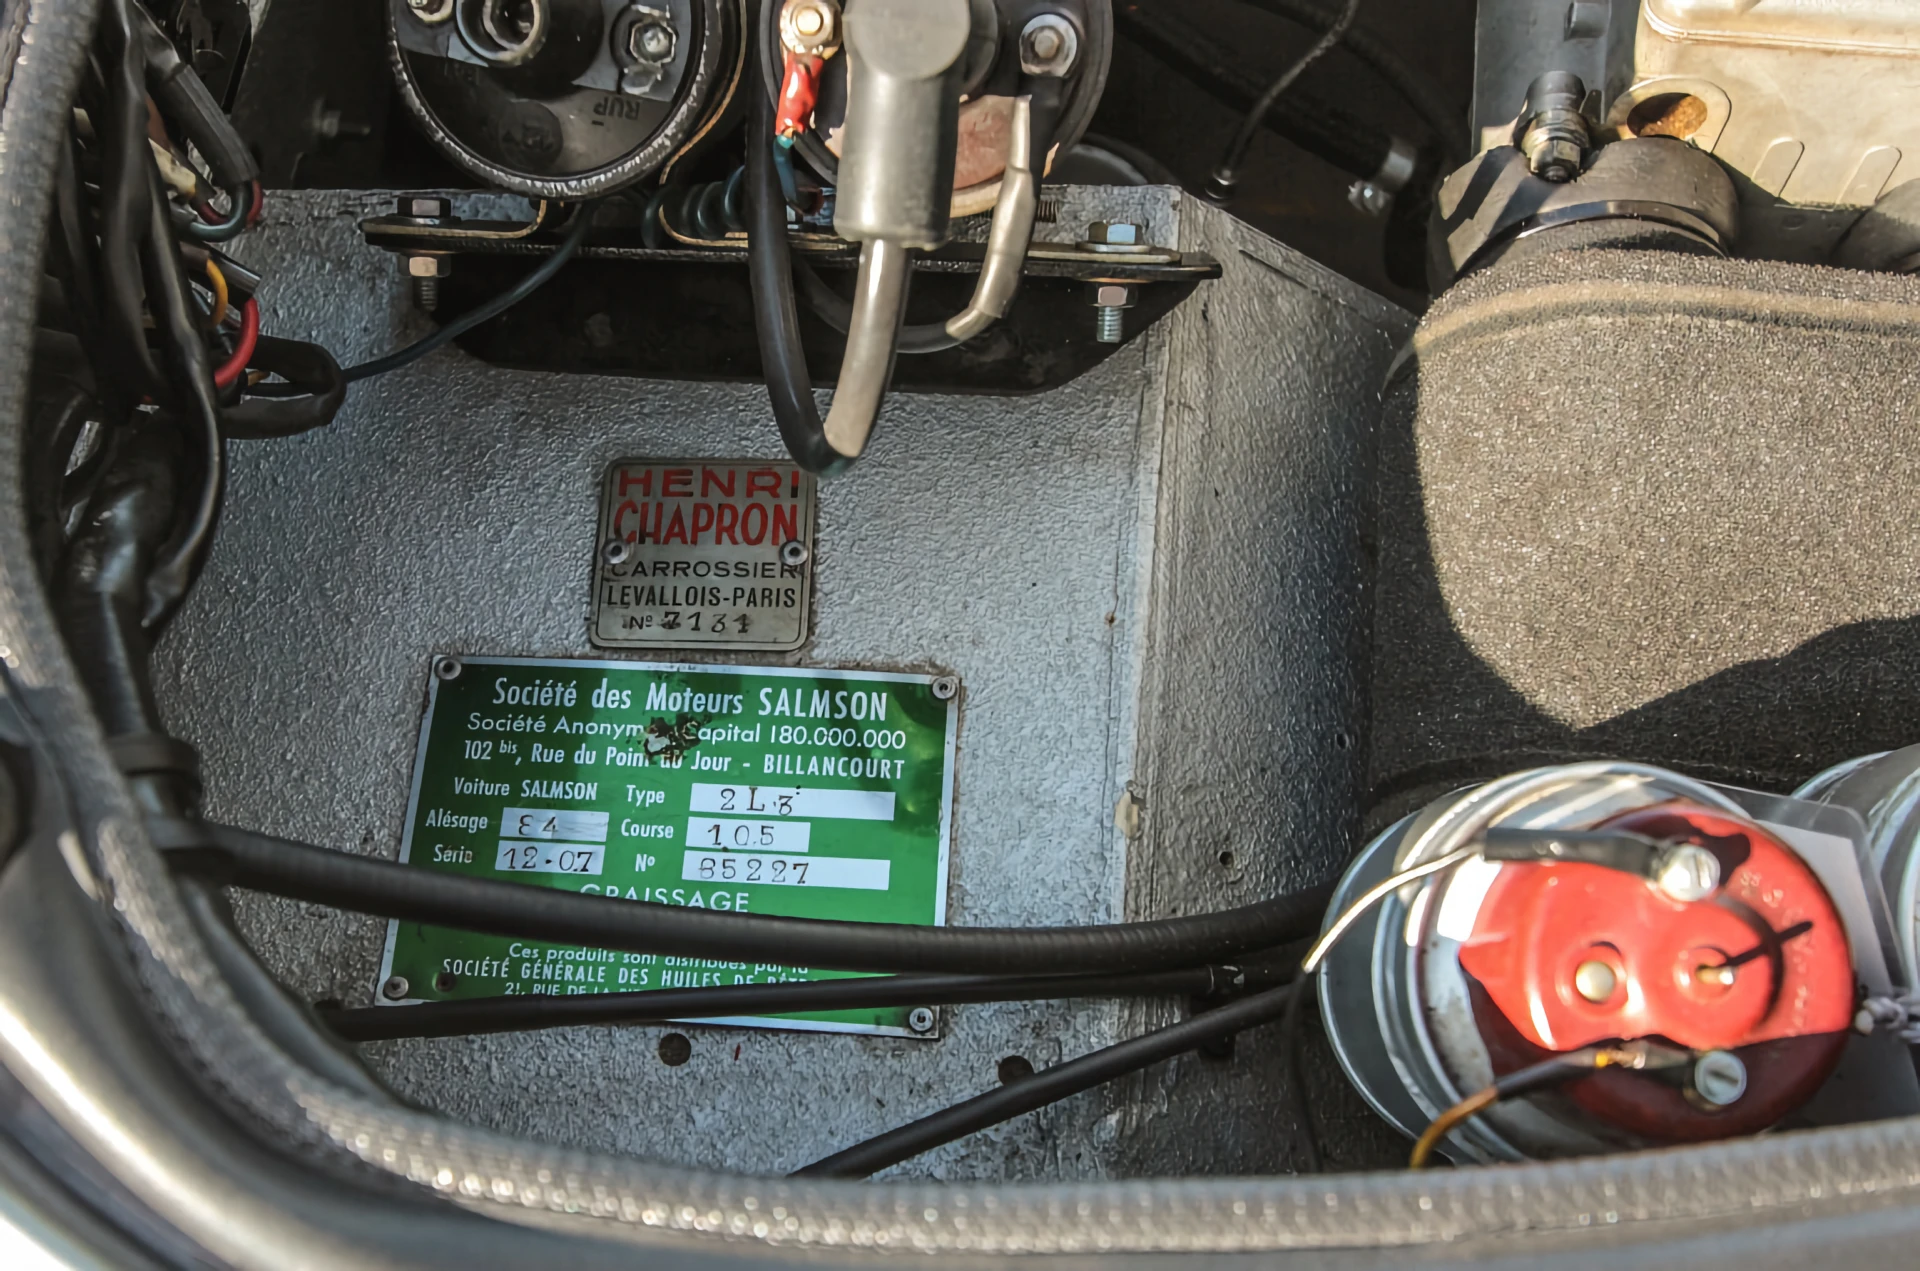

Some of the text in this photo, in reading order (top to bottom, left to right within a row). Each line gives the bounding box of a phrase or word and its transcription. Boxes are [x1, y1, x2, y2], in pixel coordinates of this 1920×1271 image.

[617, 467, 800, 499] HENRI
[613, 499, 799, 546] CHAPRON
[611, 560, 799, 579] CARROSSIER
[606, 585, 796, 608] LEVALLOIS-PARIS
[492, 676, 888, 721] Société des Moteurs SALMSON
[467, 712, 547, 733] Société
[552, 715, 648, 740] Anonym
[770, 724, 907, 750] 180.000.000
[464, 739, 493, 760] 102
[531, 742, 565, 763] Rue
[573, 743, 597, 765] du
[690, 750, 732, 772] Jour
[763, 753, 905, 780] BILLANCOURT
[454, 777, 510, 796] Voiture
[520, 779, 598, 801] SALMSON
[626, 784, 665, 807] Type
[425, 808, 489, 833] Alésage
[621, 818, 674, 838] Course
[433, 844, 474, 863] Série
[509, 942, 539, 958] Ces
[546, 946, 616, 963] produits
[443, 956, 510, 978] SOCIÉTÉ
[521, 959, 606, 983] GÉNÉRALE
[618, 966, 649, 984] DES
[661, 969, 721, 988] HUILES
[532, 982, 560, 996] RUE
